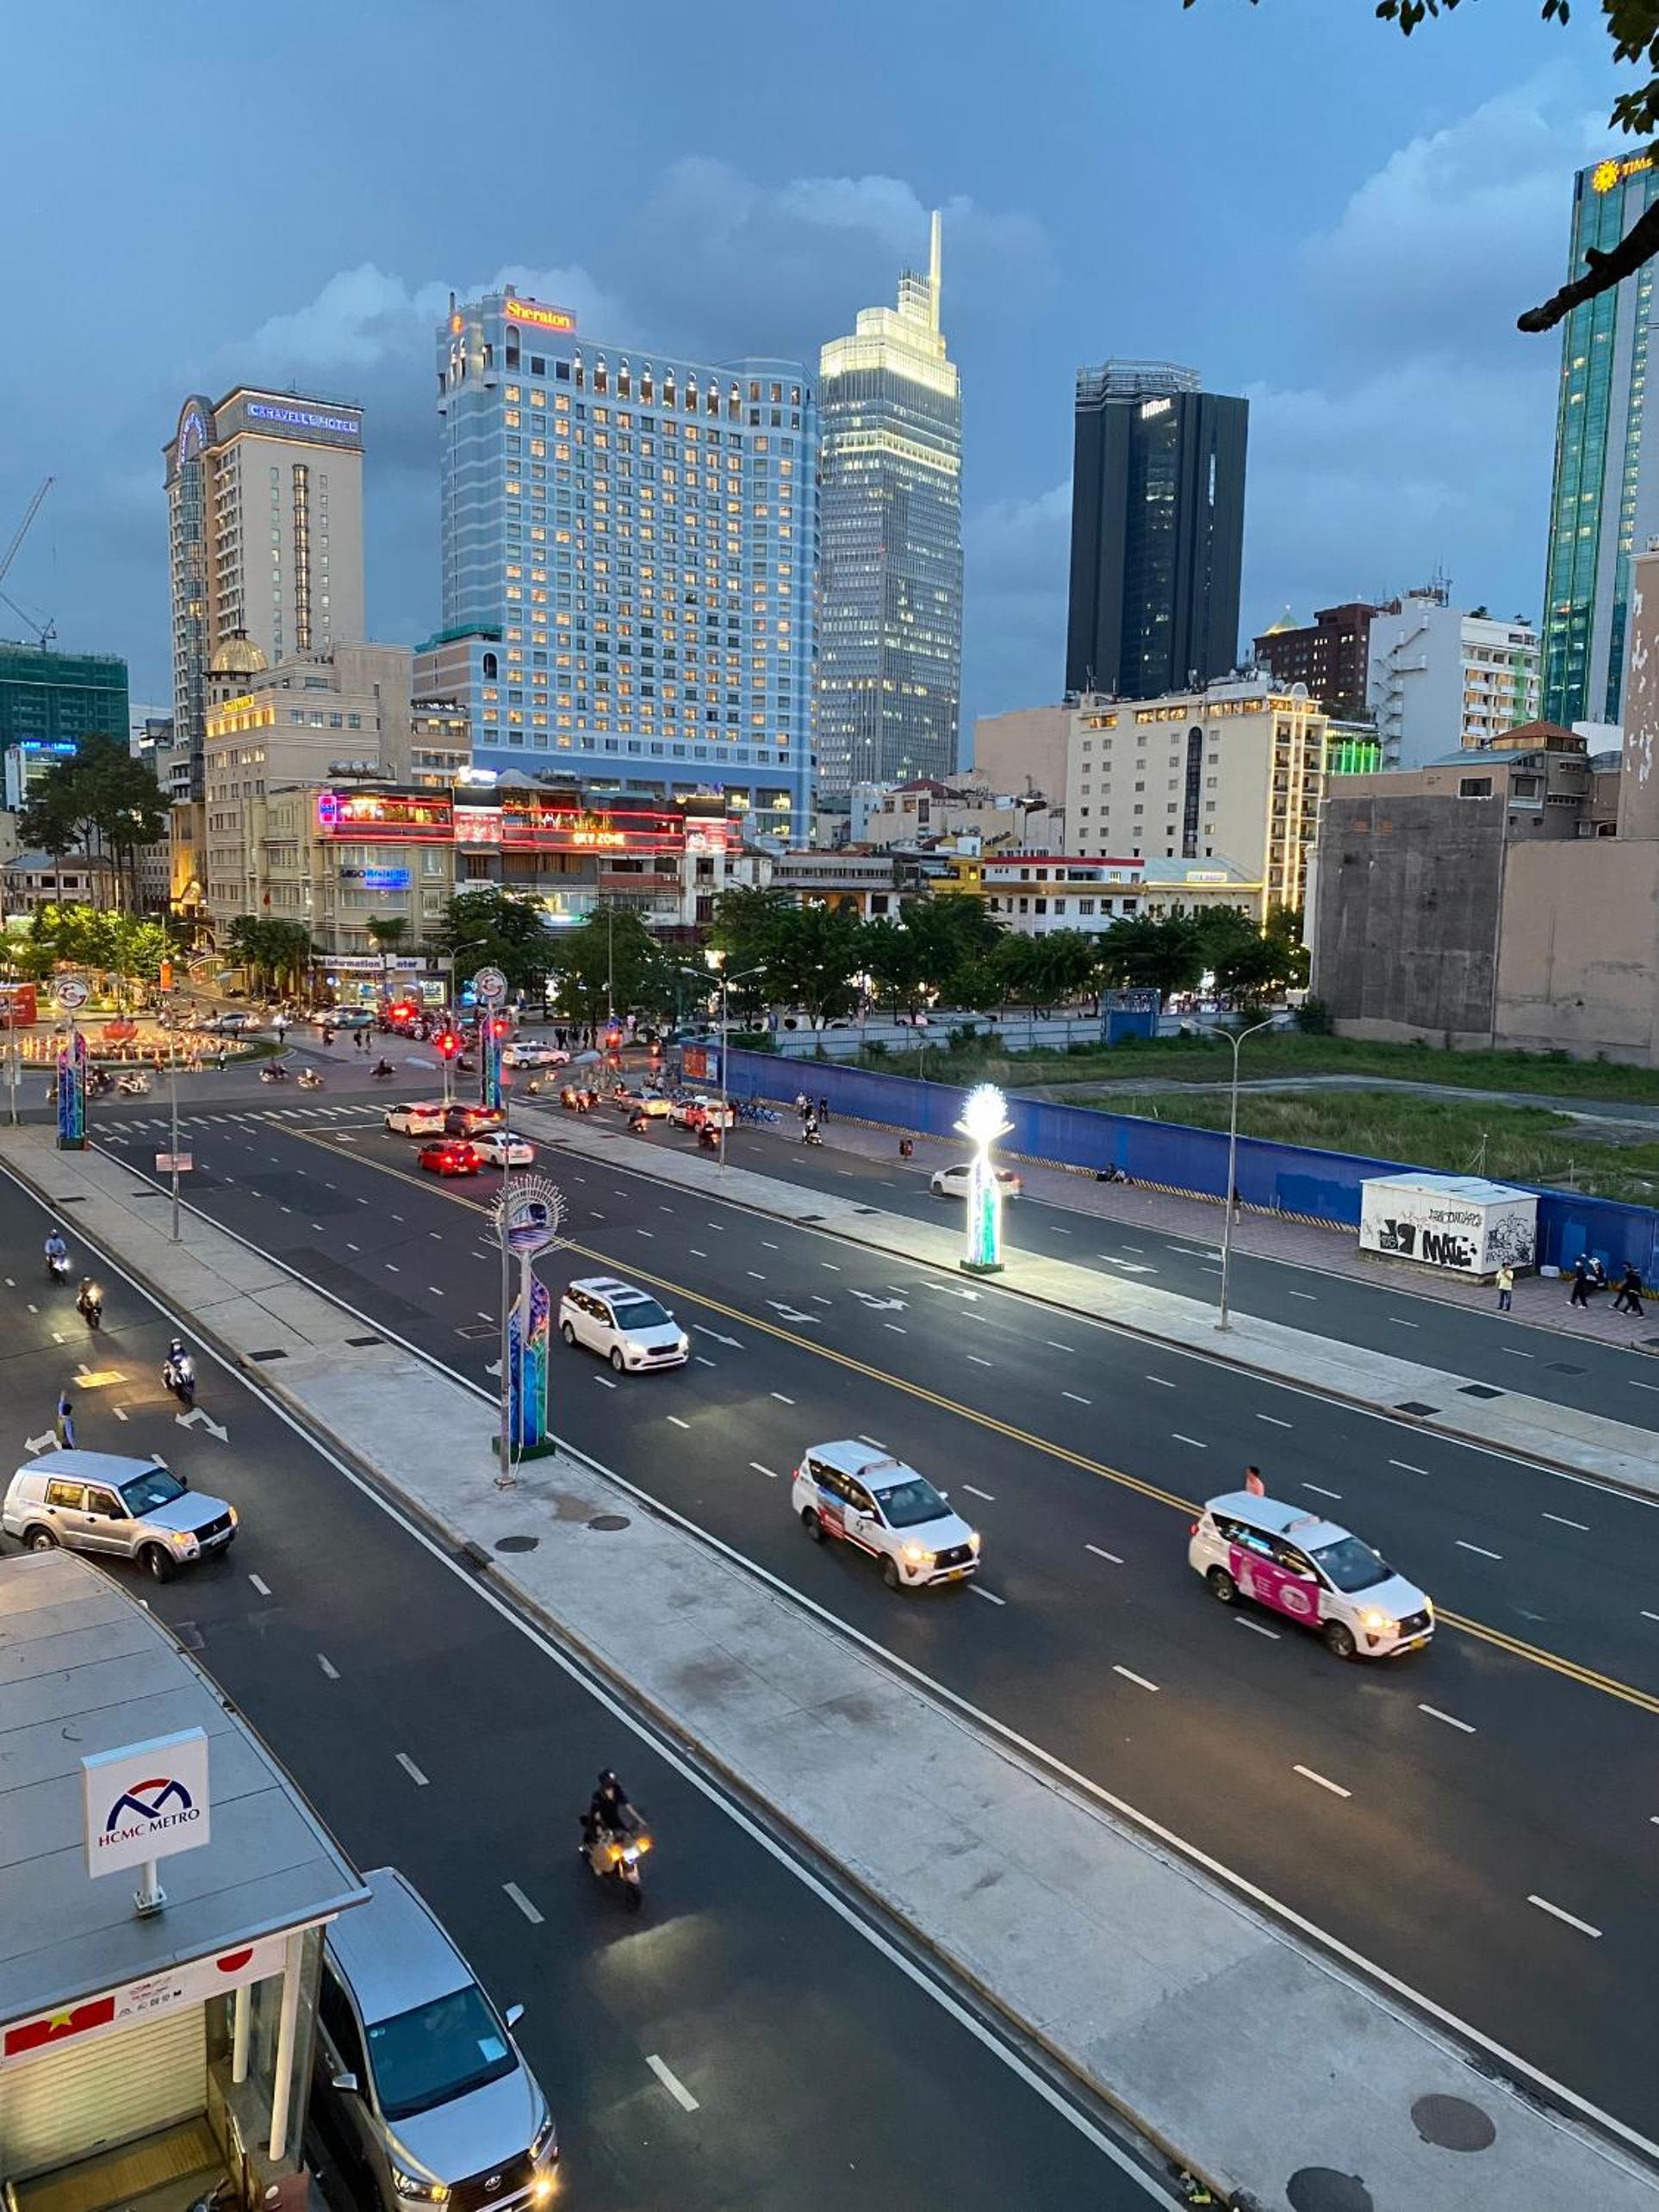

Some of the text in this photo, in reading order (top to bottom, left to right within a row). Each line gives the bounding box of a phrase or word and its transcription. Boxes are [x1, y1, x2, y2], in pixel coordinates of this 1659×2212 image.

[506, 301, 570, 328] Sheraton
[250, 404, 357, 432] CARAVELLE HOTEL
[573, 833, 594, 844] SKY
[98, 1808, 200, 1847] HCMC METRO
